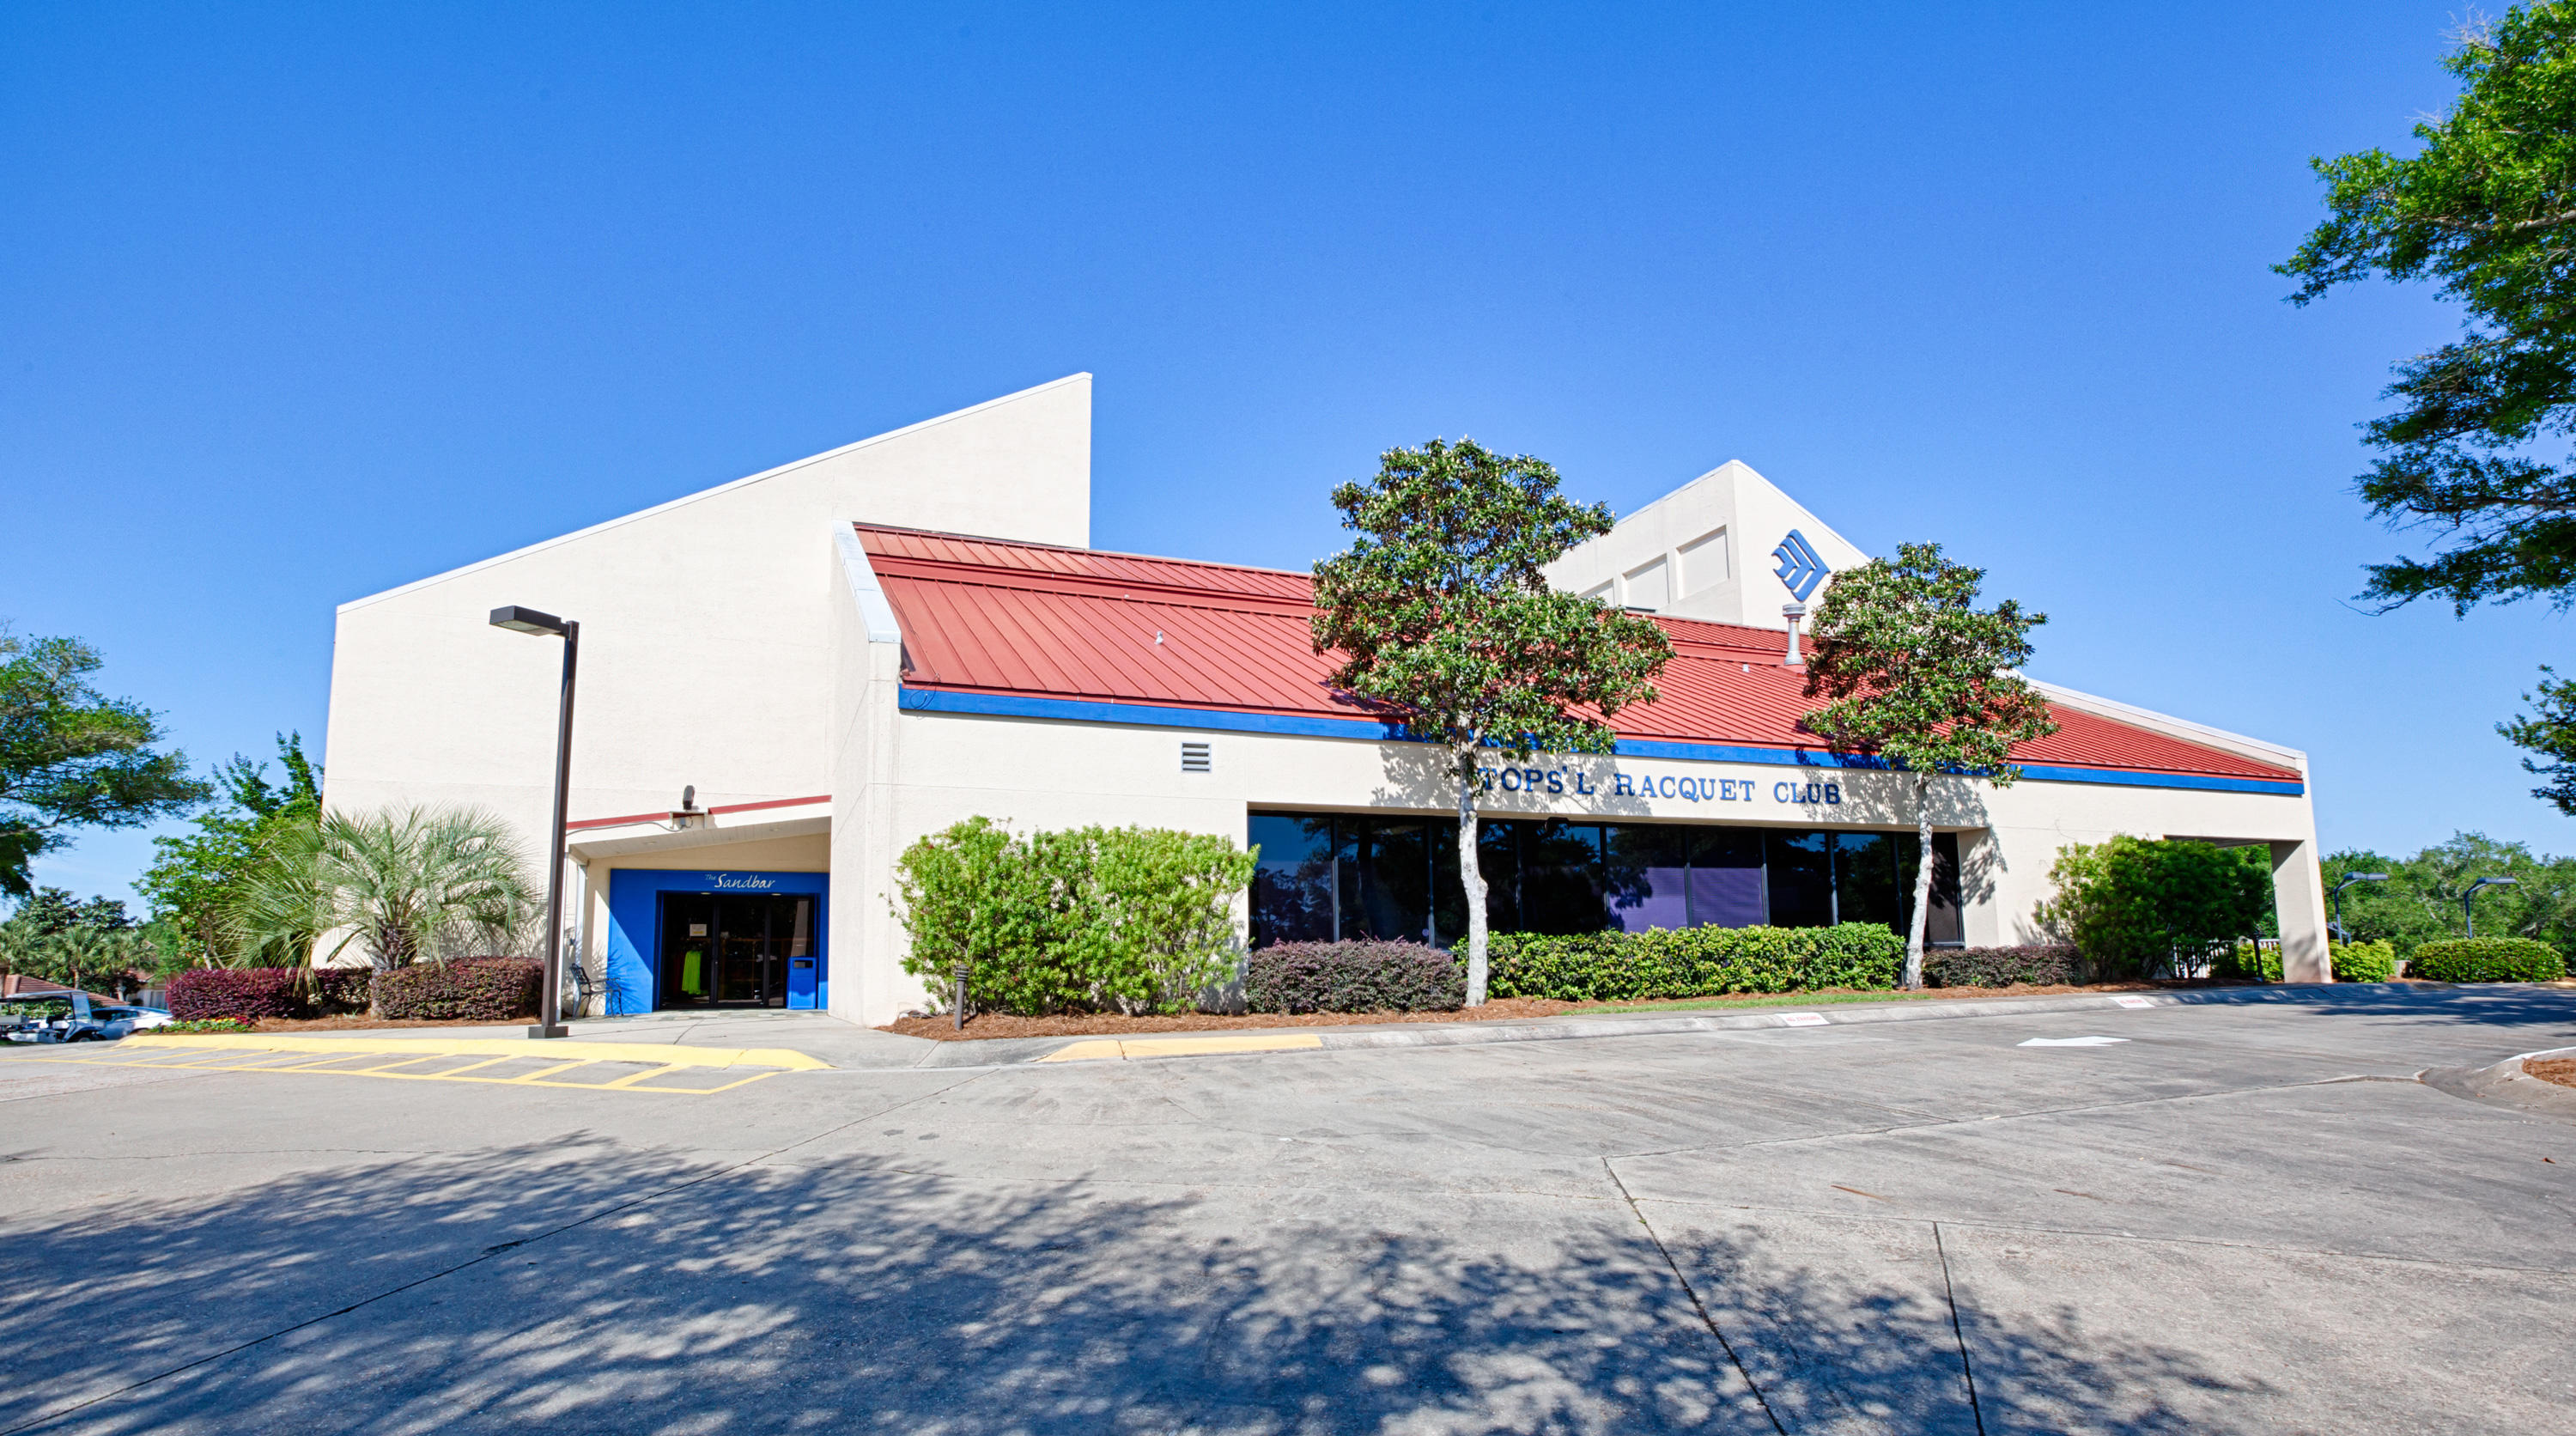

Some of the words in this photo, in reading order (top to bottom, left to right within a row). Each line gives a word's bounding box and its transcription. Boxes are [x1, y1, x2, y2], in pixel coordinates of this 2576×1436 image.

[1477, 765, 1595, 795] TOPS'L
[1613, 773, 1755, 802] RACQUET
[1773, 782, 1841, 805] CLUB
[714, 873, 775, 889] Sandbar
